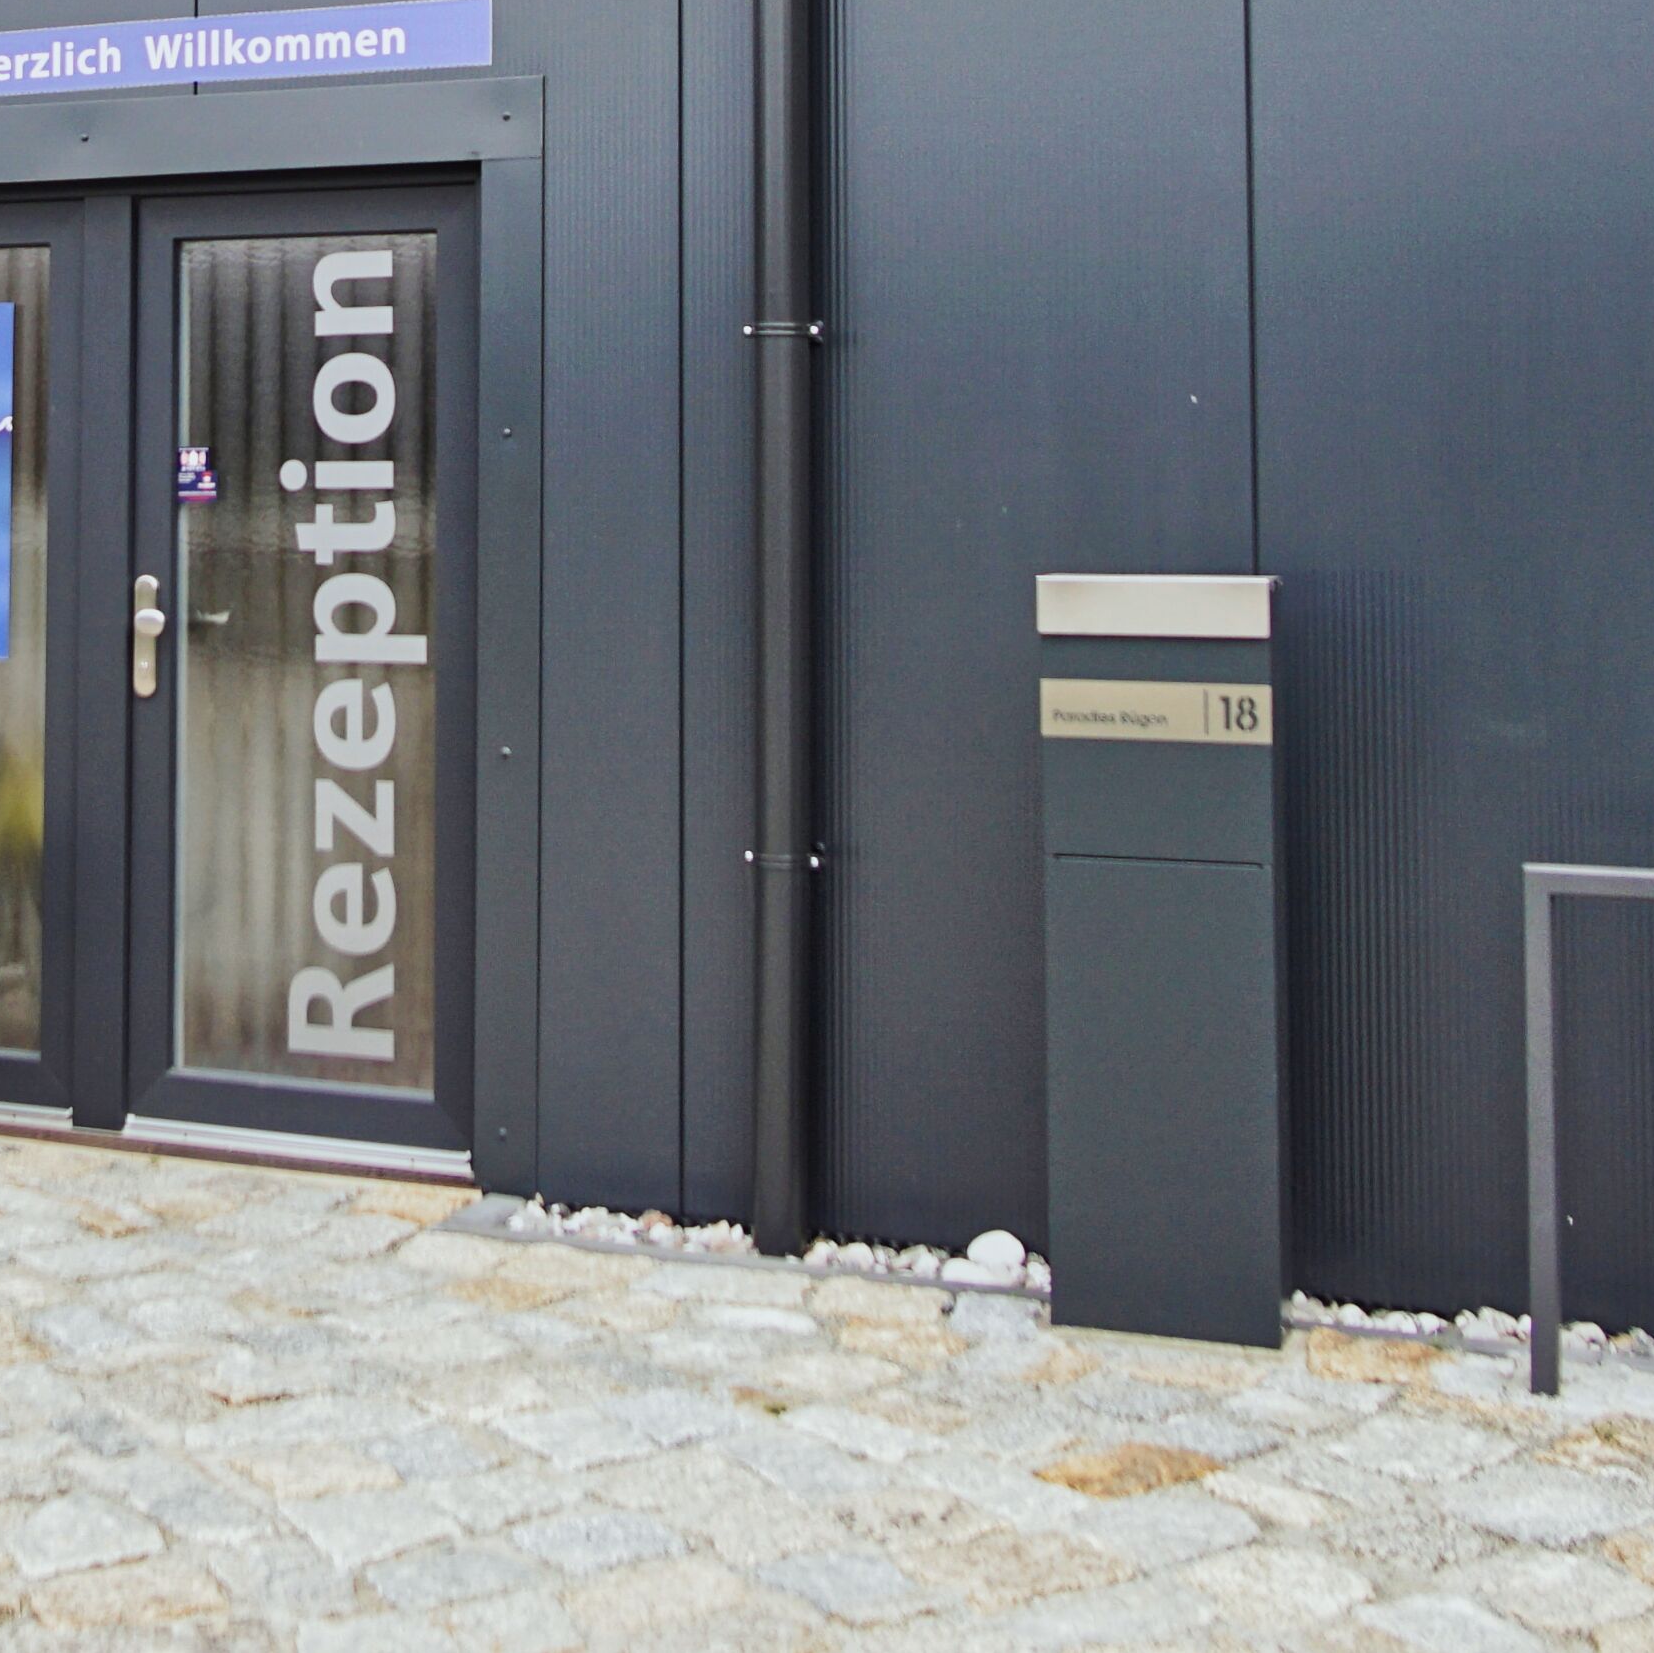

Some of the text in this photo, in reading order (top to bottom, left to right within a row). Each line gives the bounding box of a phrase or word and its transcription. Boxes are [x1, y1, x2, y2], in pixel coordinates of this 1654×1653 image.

[144, 26, 407, 71] Willkommen
[279, 248, 429, 1063] Rezeption
[1052, 696, 1259, 731] Paradies Rügen 18
